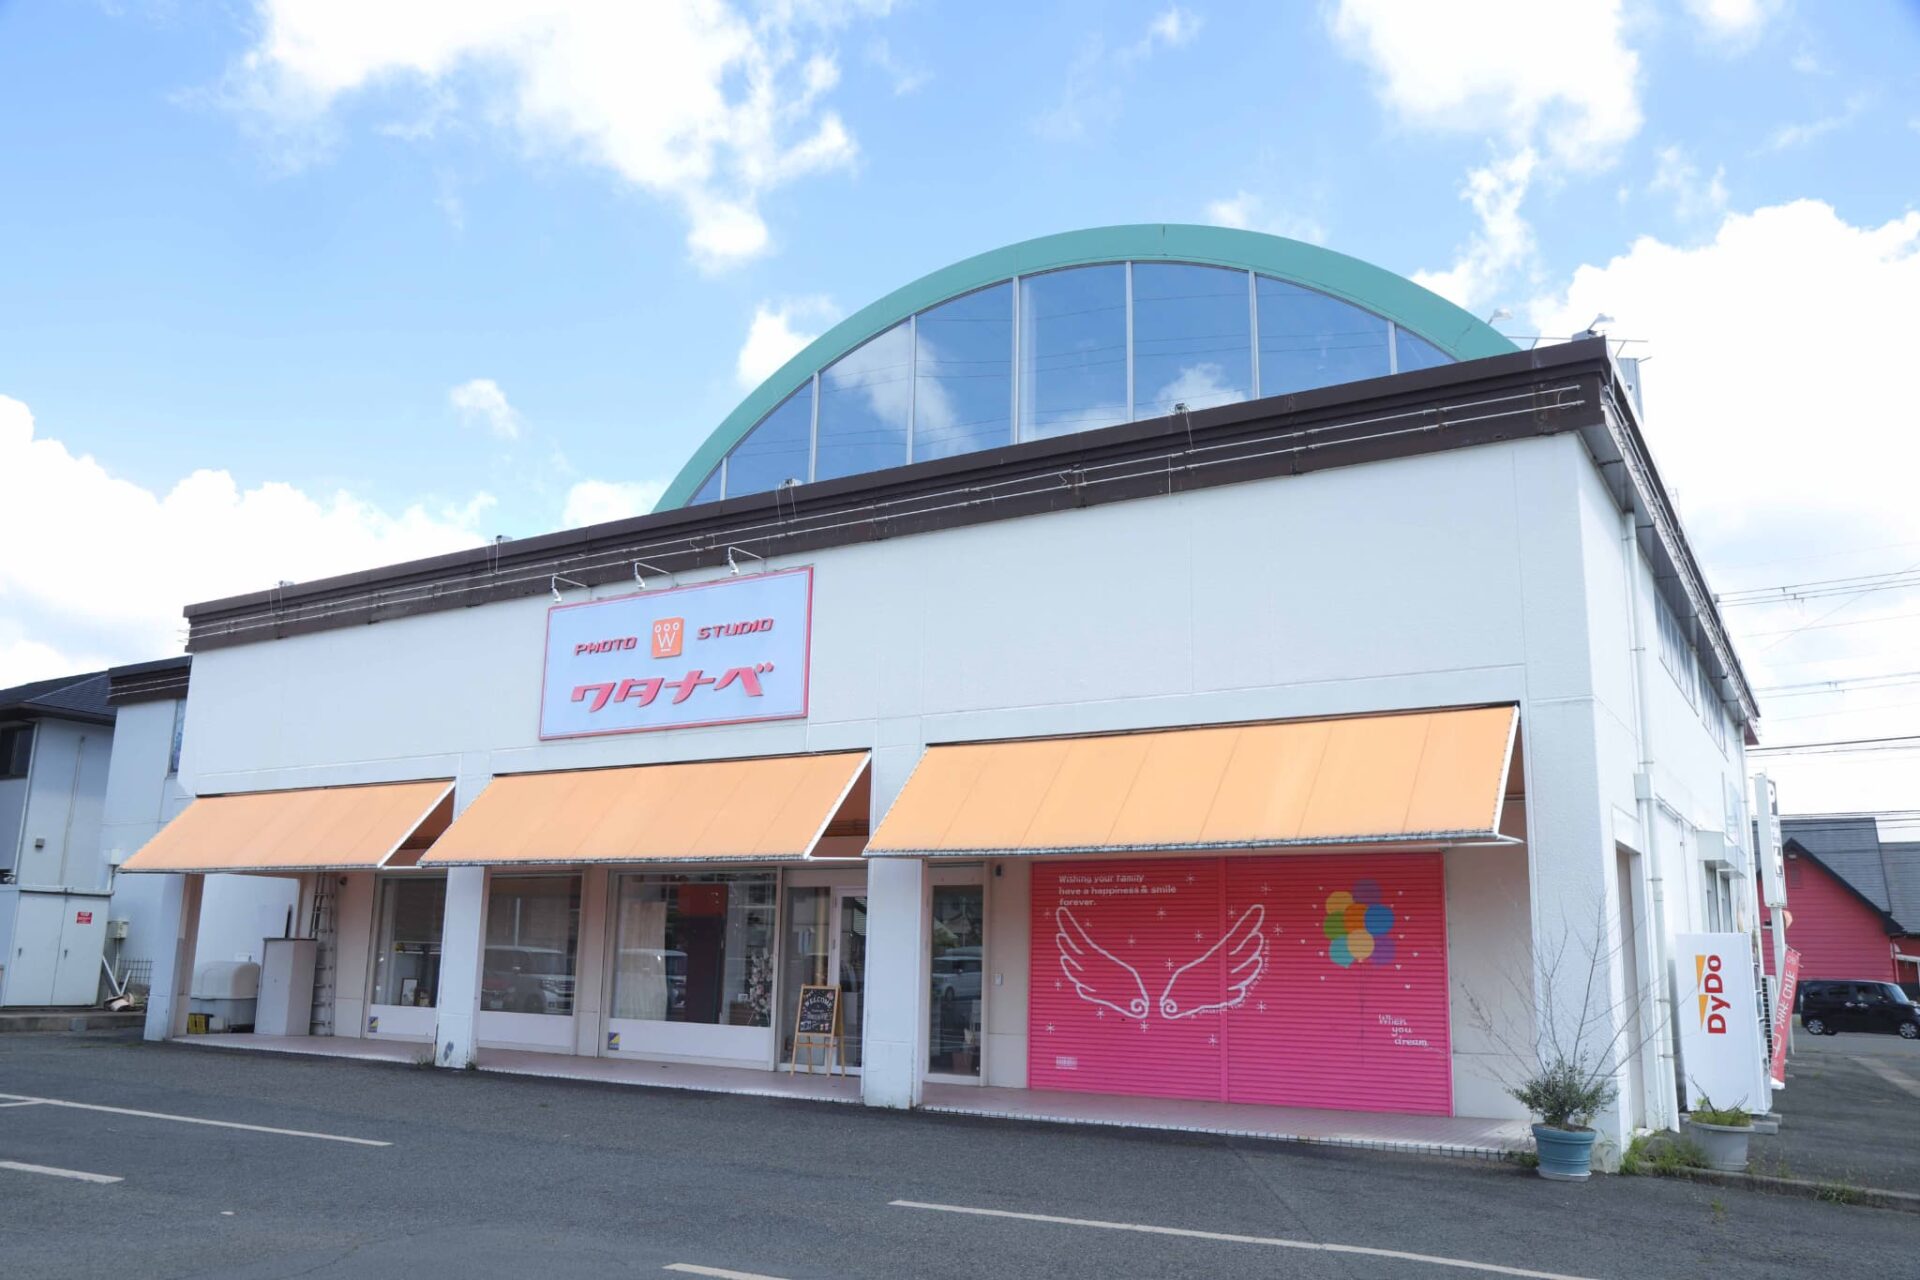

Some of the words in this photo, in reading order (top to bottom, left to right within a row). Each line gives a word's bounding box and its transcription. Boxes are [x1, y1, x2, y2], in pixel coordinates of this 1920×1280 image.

[574, 636, 638, 656] PHOTO
[696, 617, 775, 641] STUDIO
[570, 661, 775, 713] ワタナベ
[1058, 874, 1092, 885] Wishing
[1093, 874, 1114, 885] your
[1058, 886, 1081, 895] have
[1090, 886, 1139, 897] happiness
[1150, 884, 1177, 895] smile
[1704, 954, 1732, 1035] DyDo
[1378, 1013, 1408, 1026] When
[1391, 1026, 1413, 1037] you
